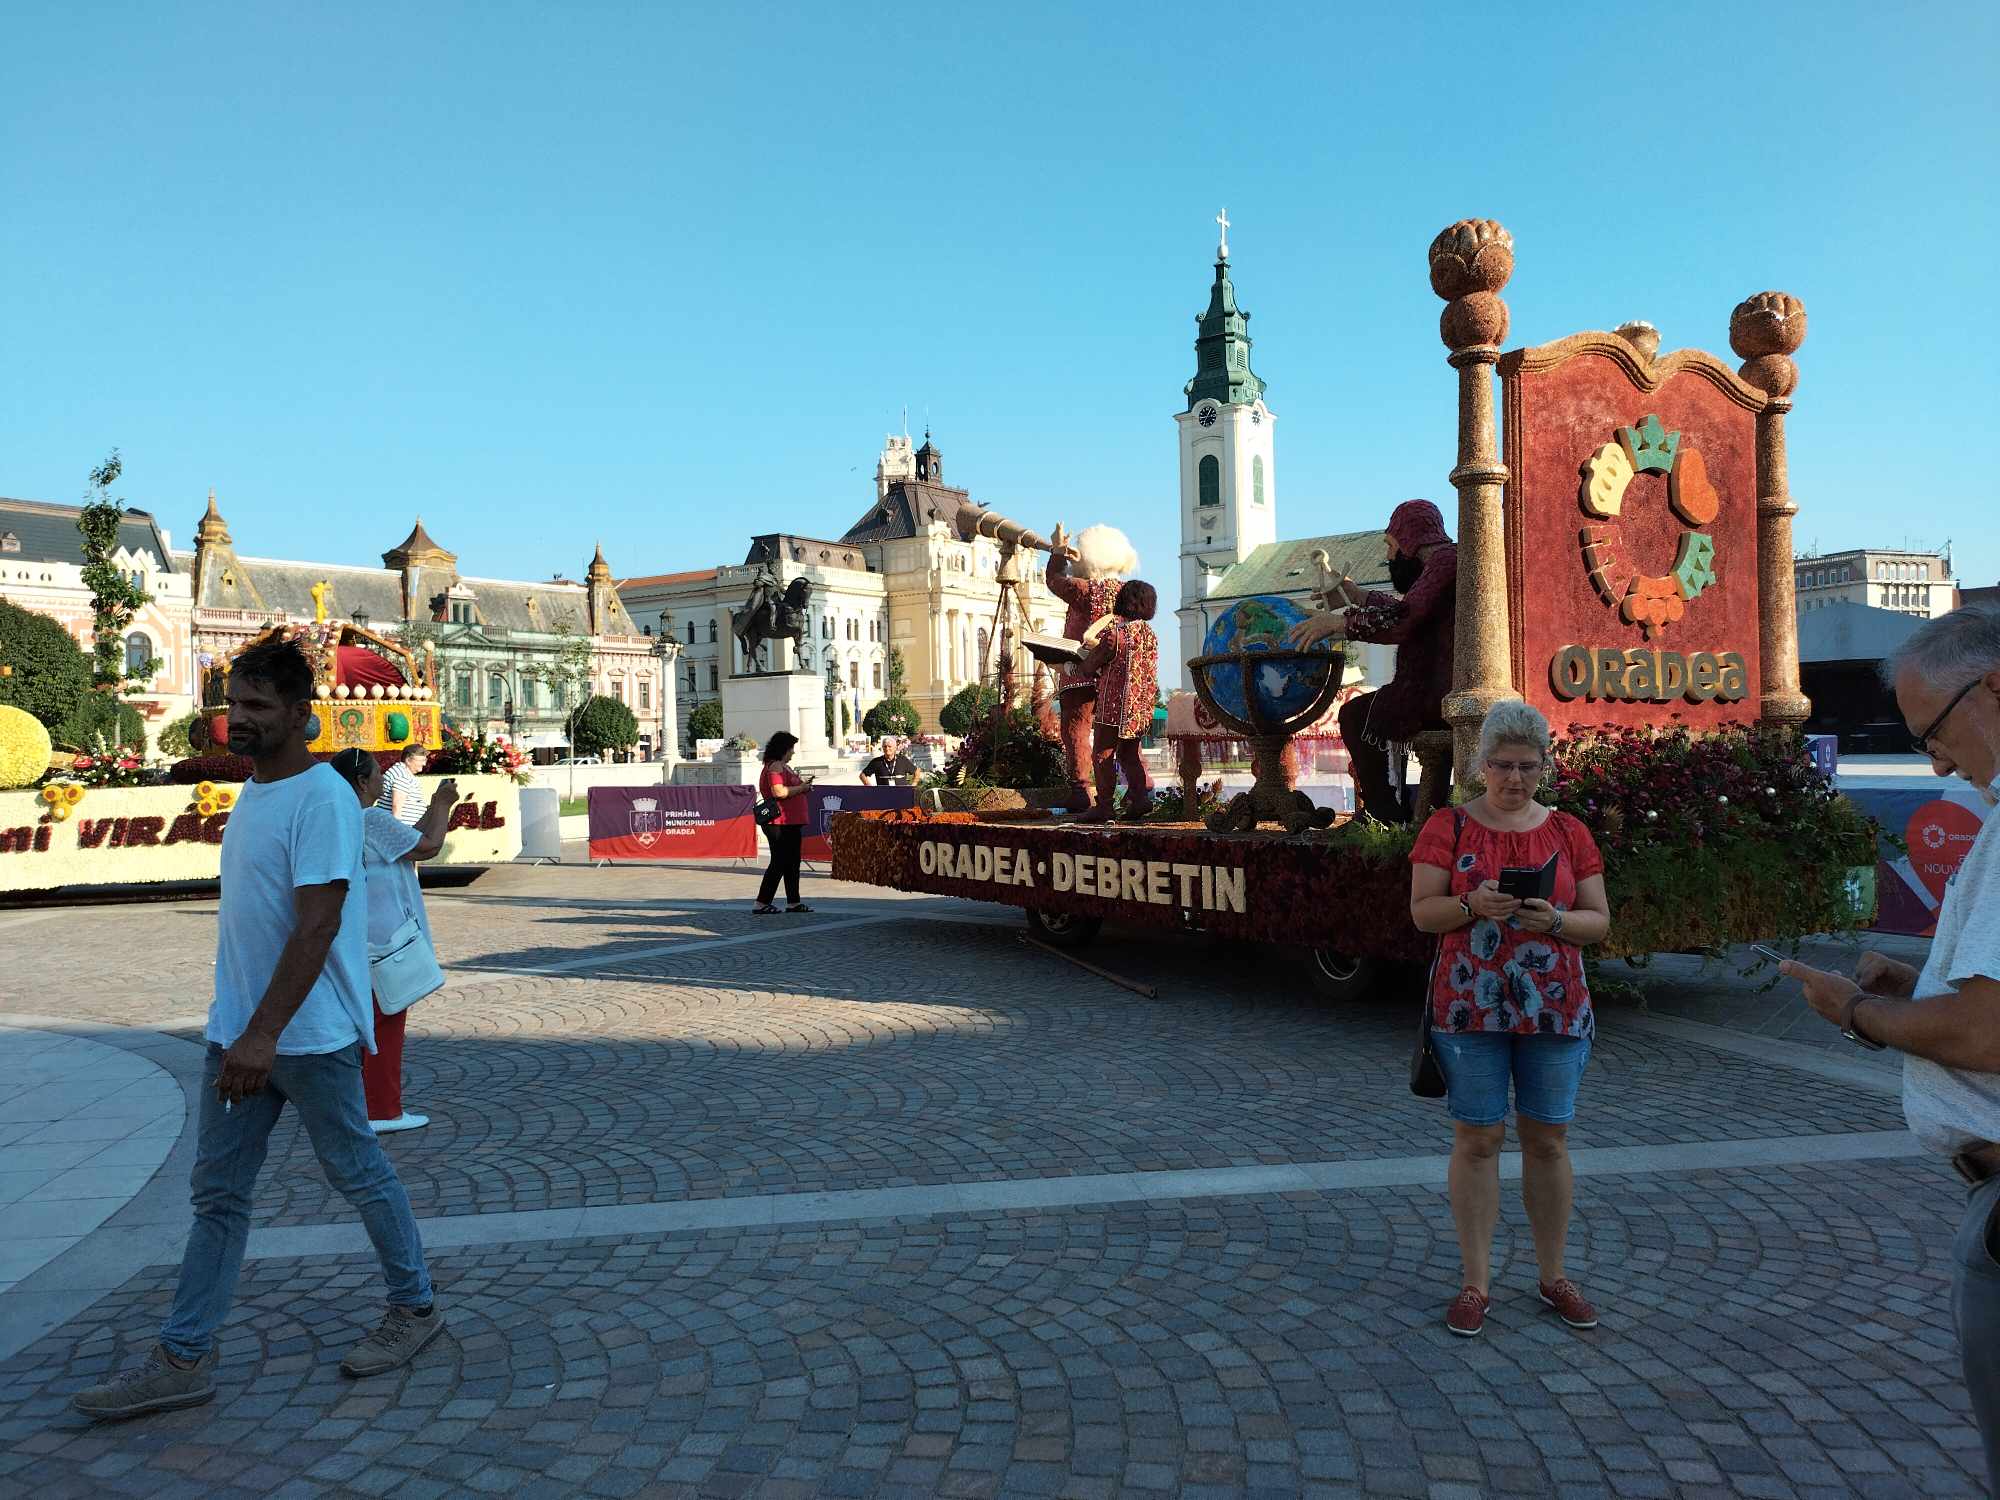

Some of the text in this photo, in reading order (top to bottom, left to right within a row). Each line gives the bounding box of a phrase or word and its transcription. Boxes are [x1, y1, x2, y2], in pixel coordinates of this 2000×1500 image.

[665, 819, 715, 827] MUNICIPIULUI
[919, 840, 1035, 887] ORADEA
[1052, 851, 1247, 914] DEBRETIN
